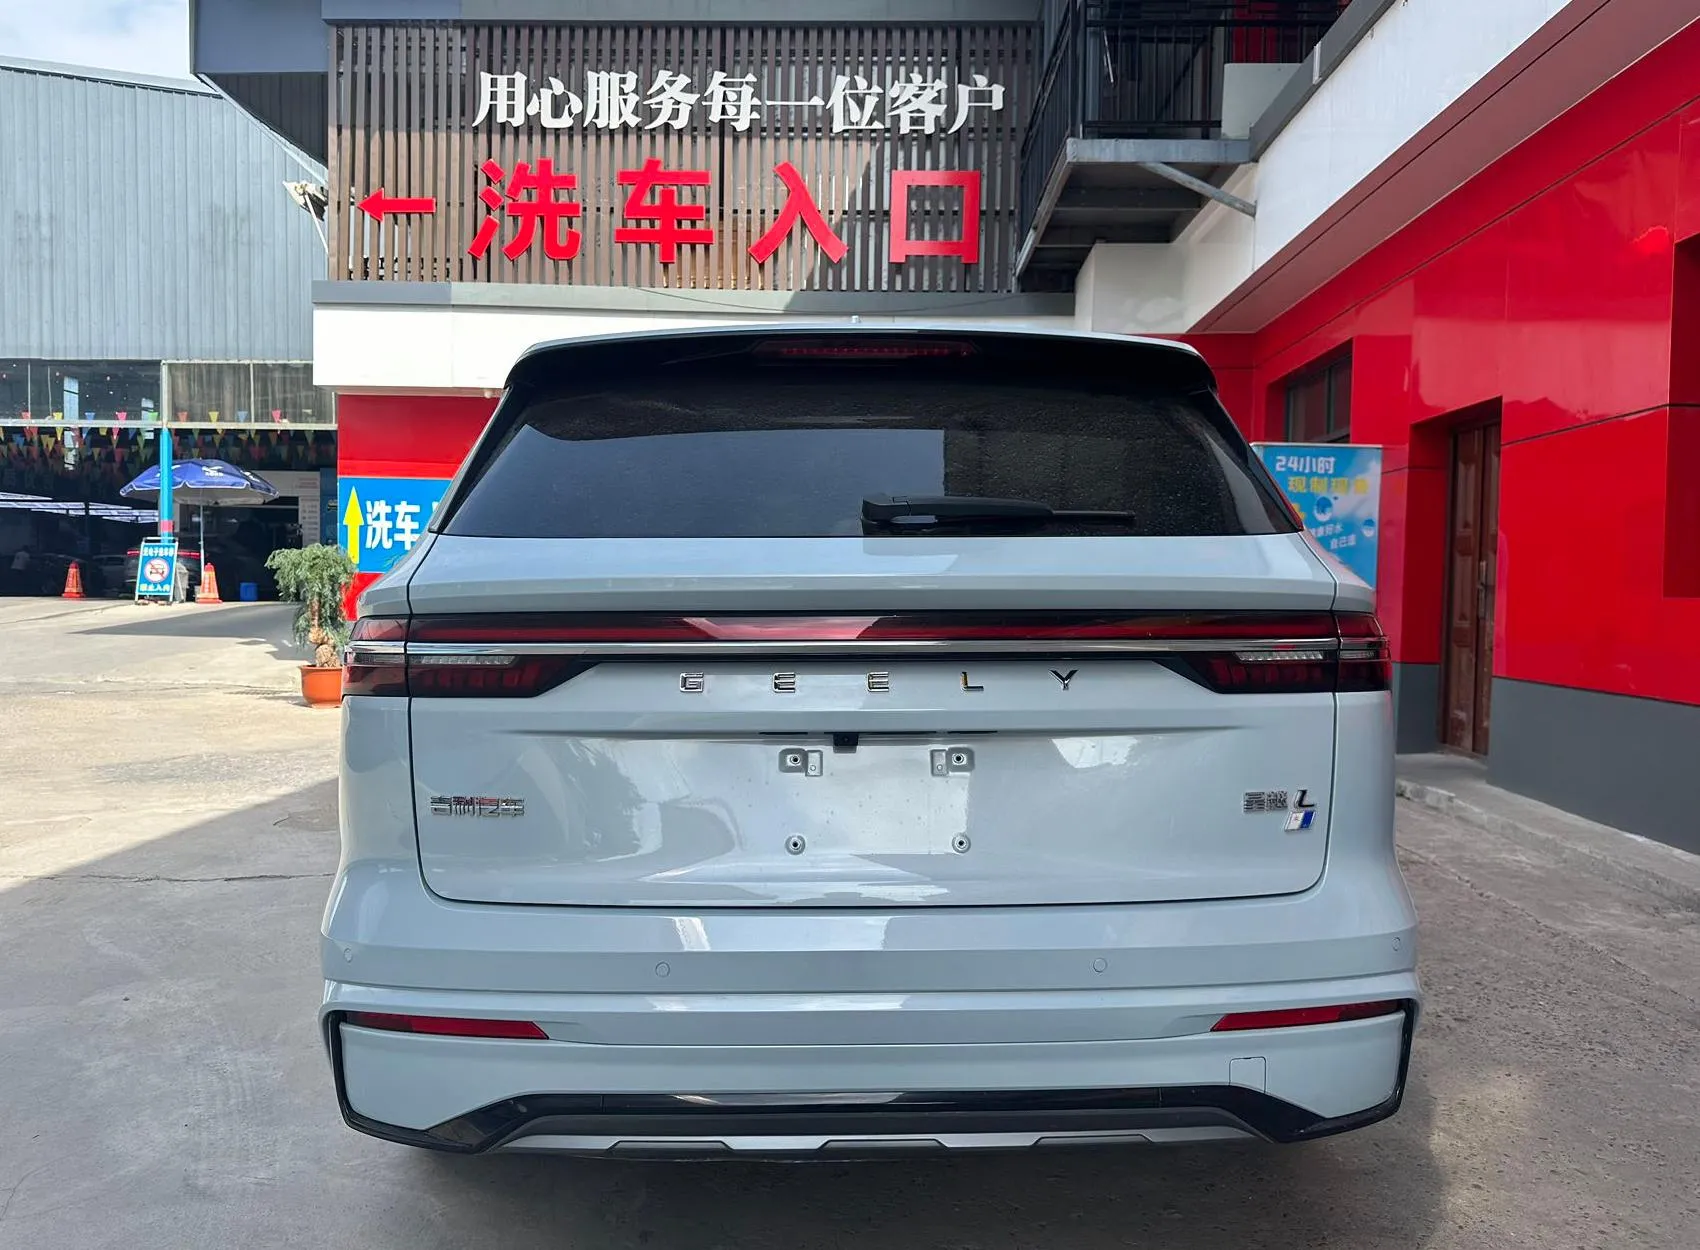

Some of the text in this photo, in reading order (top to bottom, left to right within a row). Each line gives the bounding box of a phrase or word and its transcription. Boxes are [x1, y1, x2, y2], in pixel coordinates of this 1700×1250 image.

[473, 71, 1005, 135] 用心服务每一位客户
[467, 157, 981, 264] 洗车入口
[1275, 456, 1336, 474] 24小时
[365, 500, 440, 551] 洗车
[679, 668, 1079, 693] GEELY
[430, 796, 525, 817] 吉利汽车
[1294, 788, 1317, 809] L
